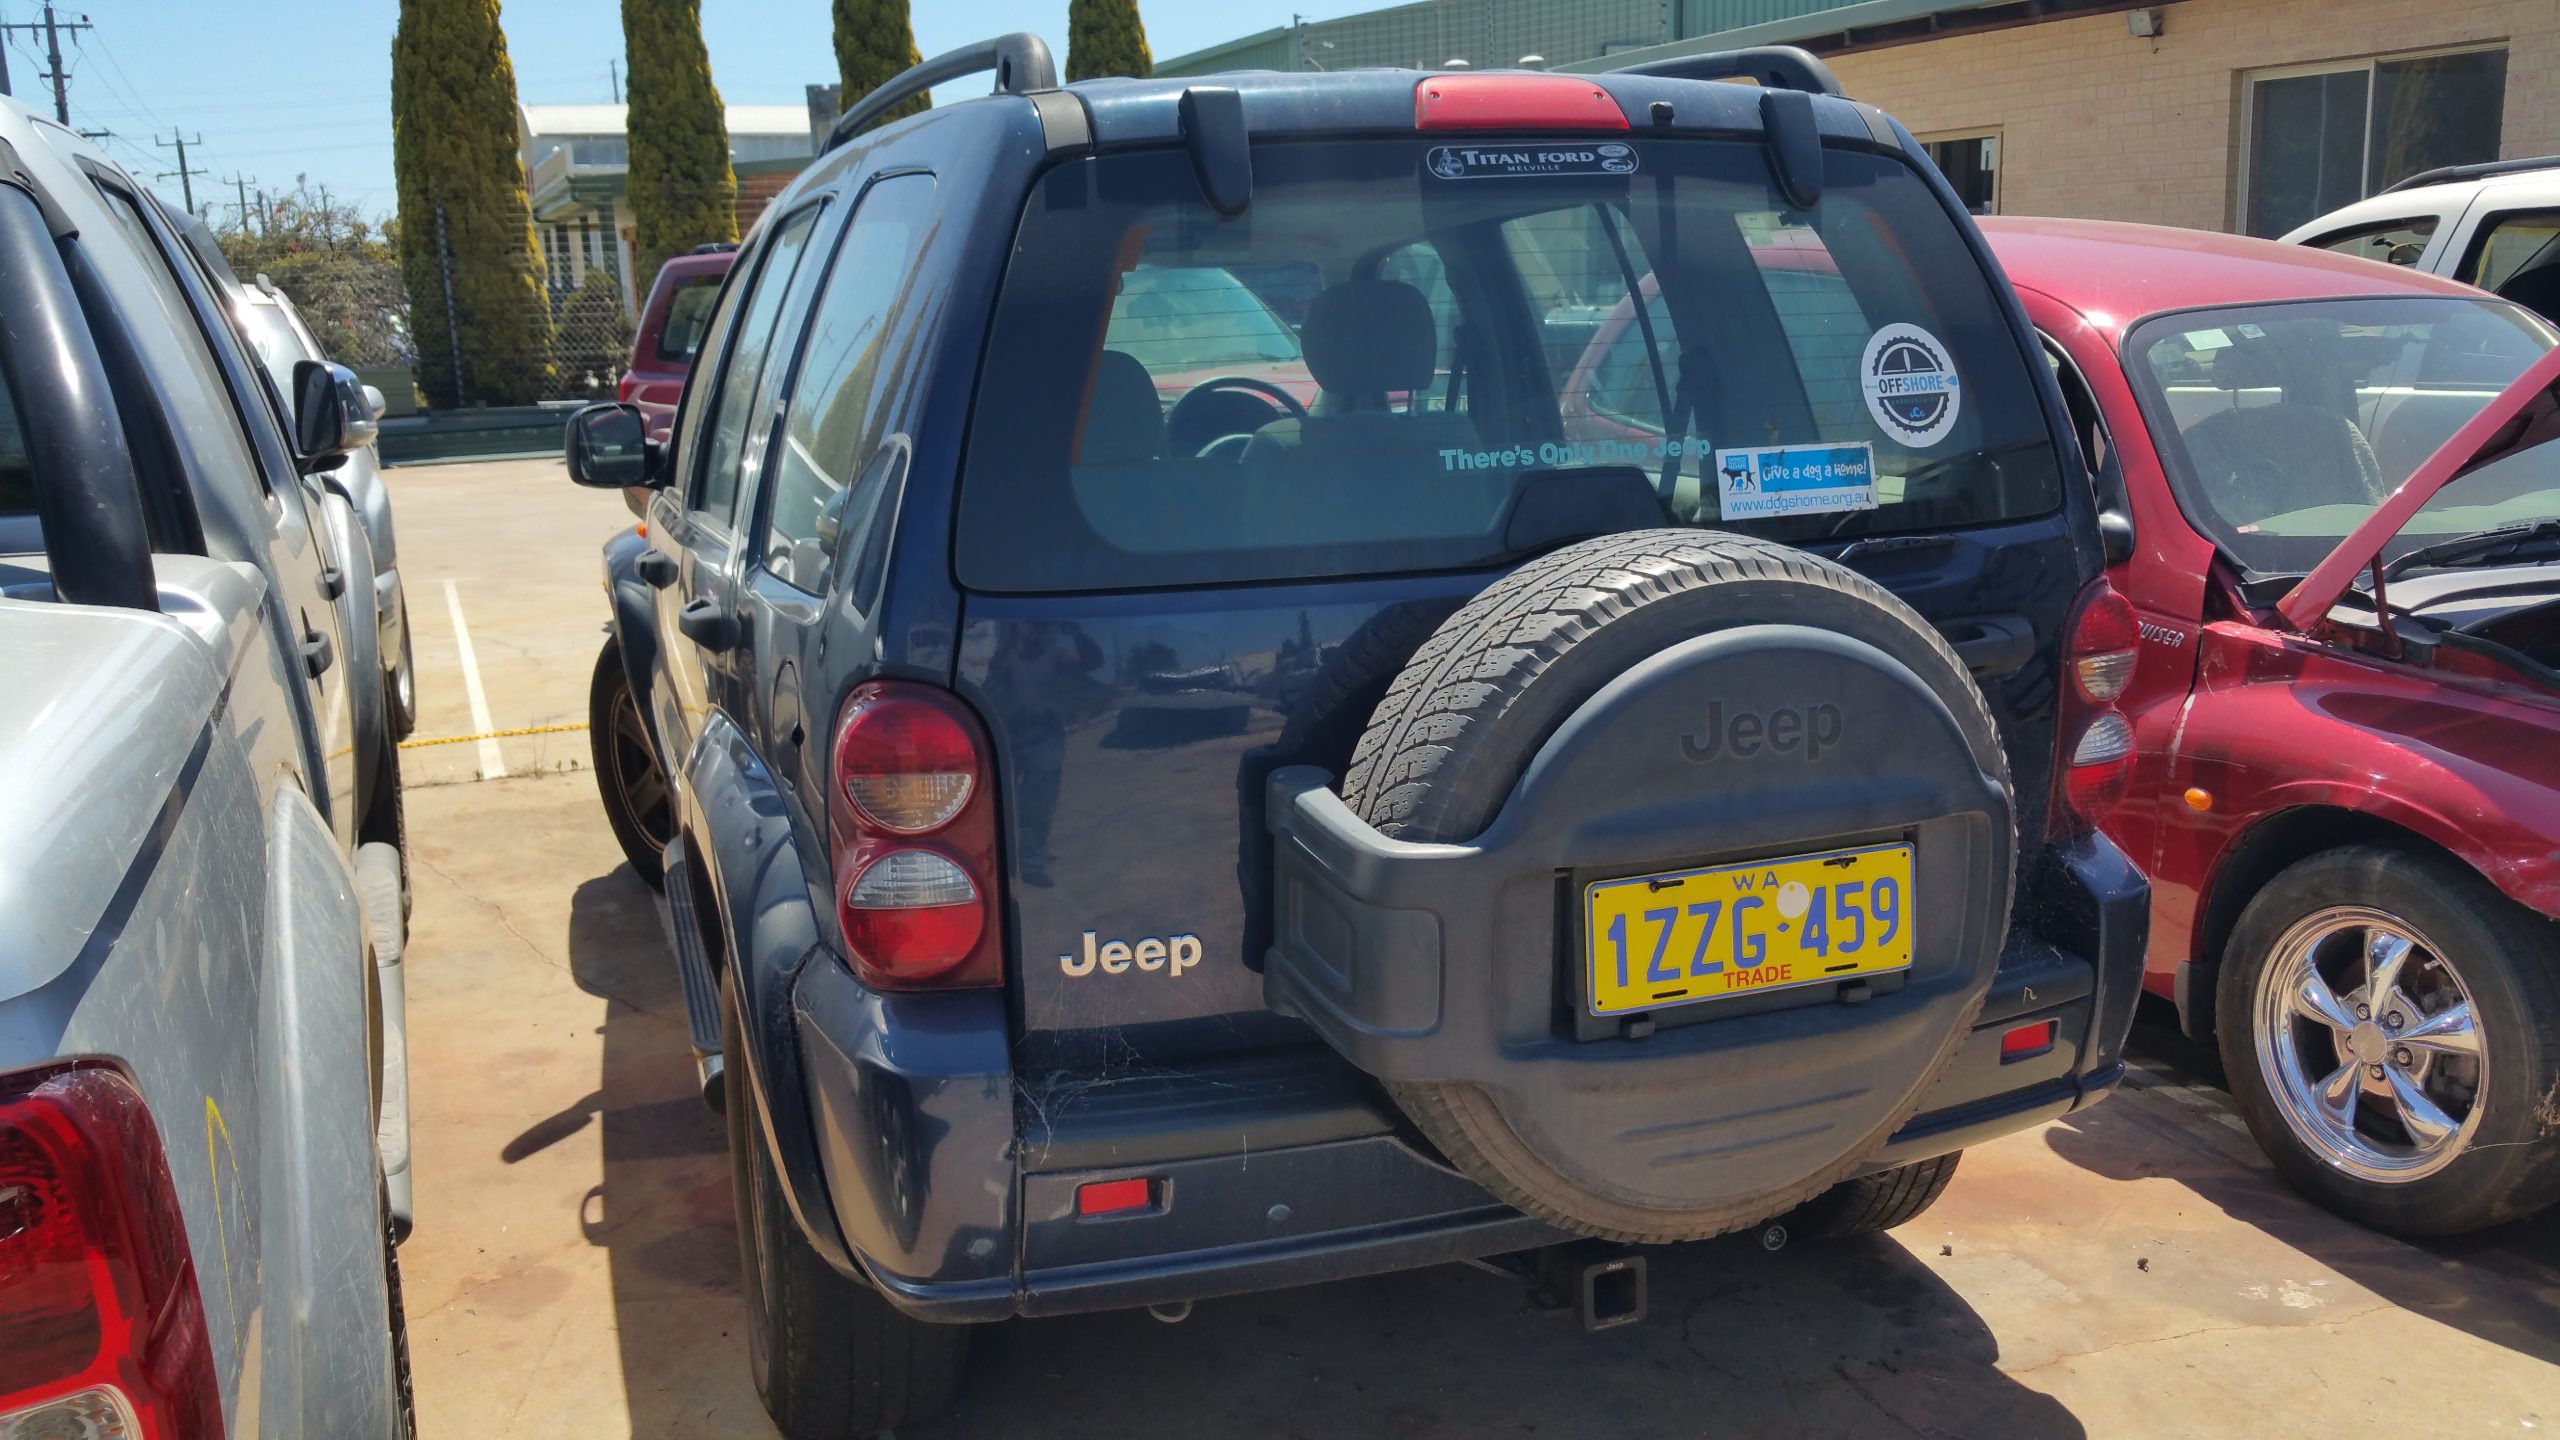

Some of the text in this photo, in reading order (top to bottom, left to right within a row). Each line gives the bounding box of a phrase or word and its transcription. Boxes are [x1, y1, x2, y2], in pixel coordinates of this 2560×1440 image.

[1460, 150, 1595, 166] TITAN FORD
[1507, 164, 1561, 172] MELVILLE
[1878, 375, 1944, 394] OFFSHORE
[1439, 438, 1711, 471] There's Only One Jeep
[1793, 467, 1800, 479] a
[1802, 464, 1821, 482] dog
[1824, 465, 1832, 478] a
[1730, 492, 1870, 513] www.dogshome.org.au
[1680, 700, 1842, 764] Jeep
[1732, 871, 1780, 892] WA
[1059, 930, 1202, 977] Jeep
[1723, 963, 1793, 989] TRADE
